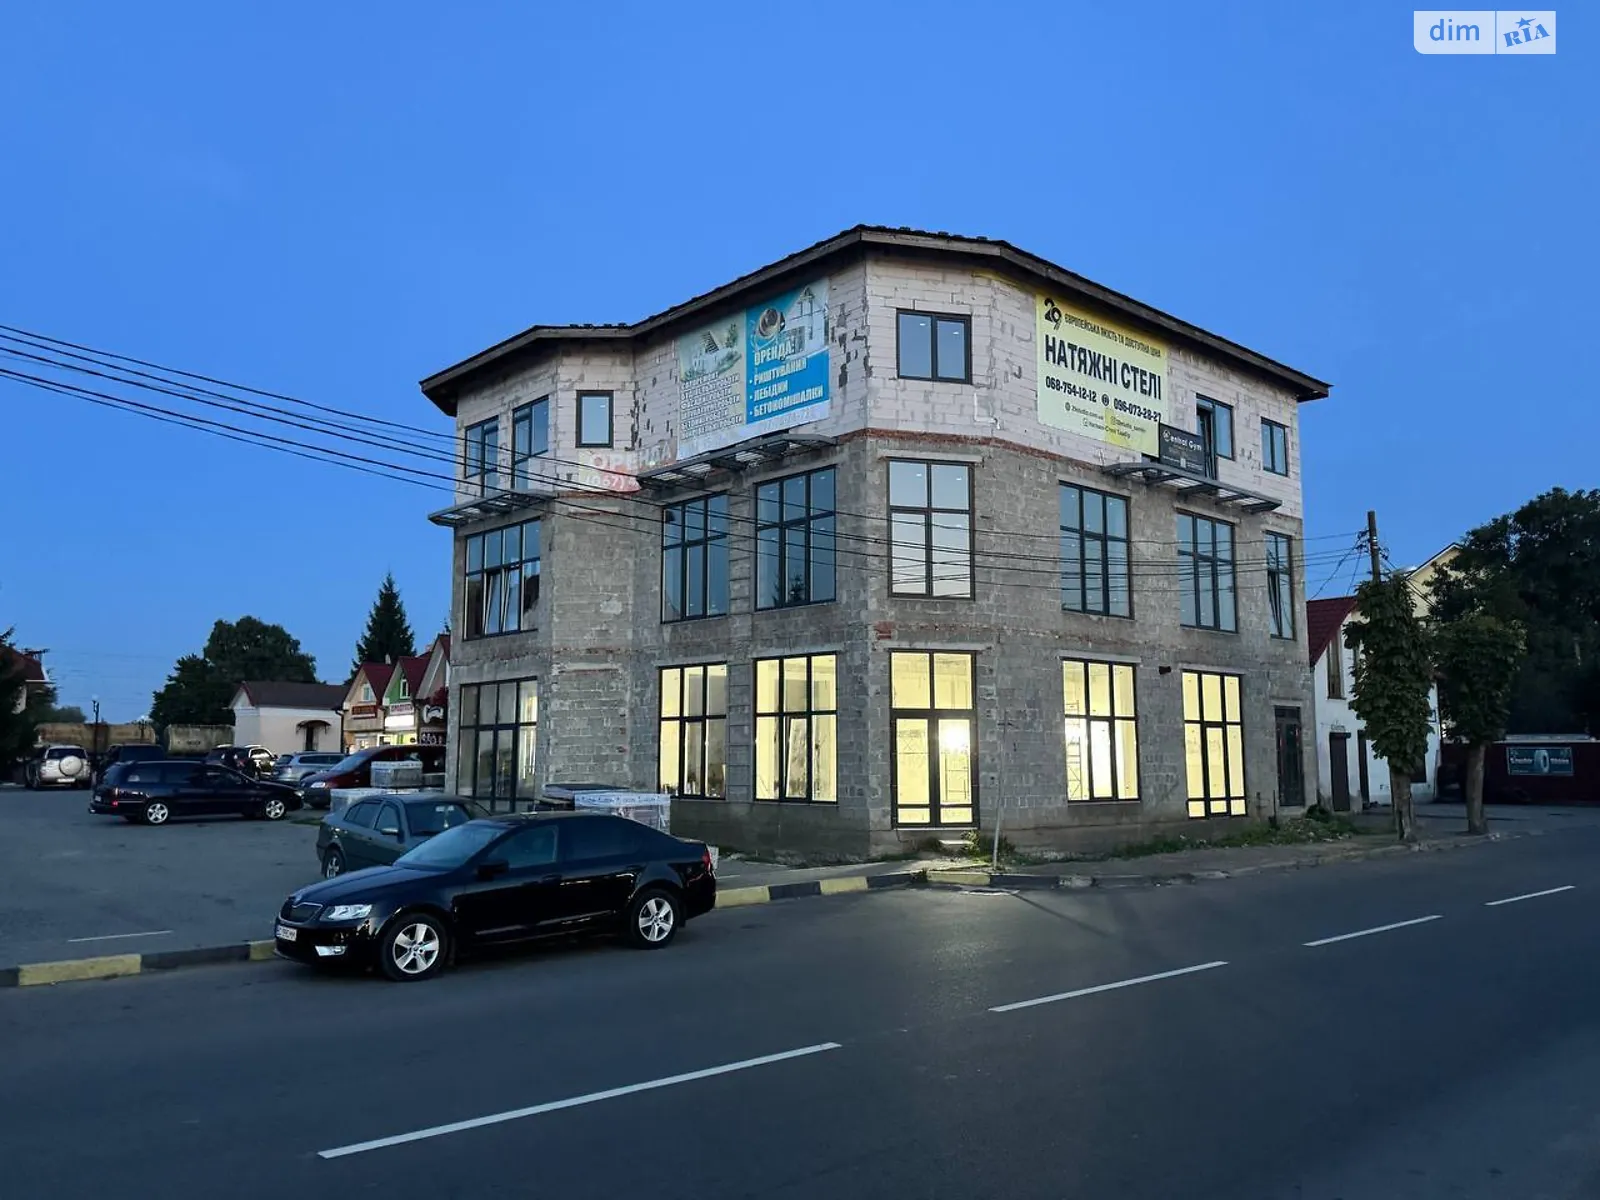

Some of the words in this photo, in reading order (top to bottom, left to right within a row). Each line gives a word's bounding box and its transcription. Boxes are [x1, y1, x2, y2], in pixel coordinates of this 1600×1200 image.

[1045, 334, 1118, 385] НАТЯЖНІ
[1121, 360, 1162, 401] СТЕЛІ
[1045, 375, 1097, 403] 068-754-12-12
[1188, 440, 1202, 451] Gym
